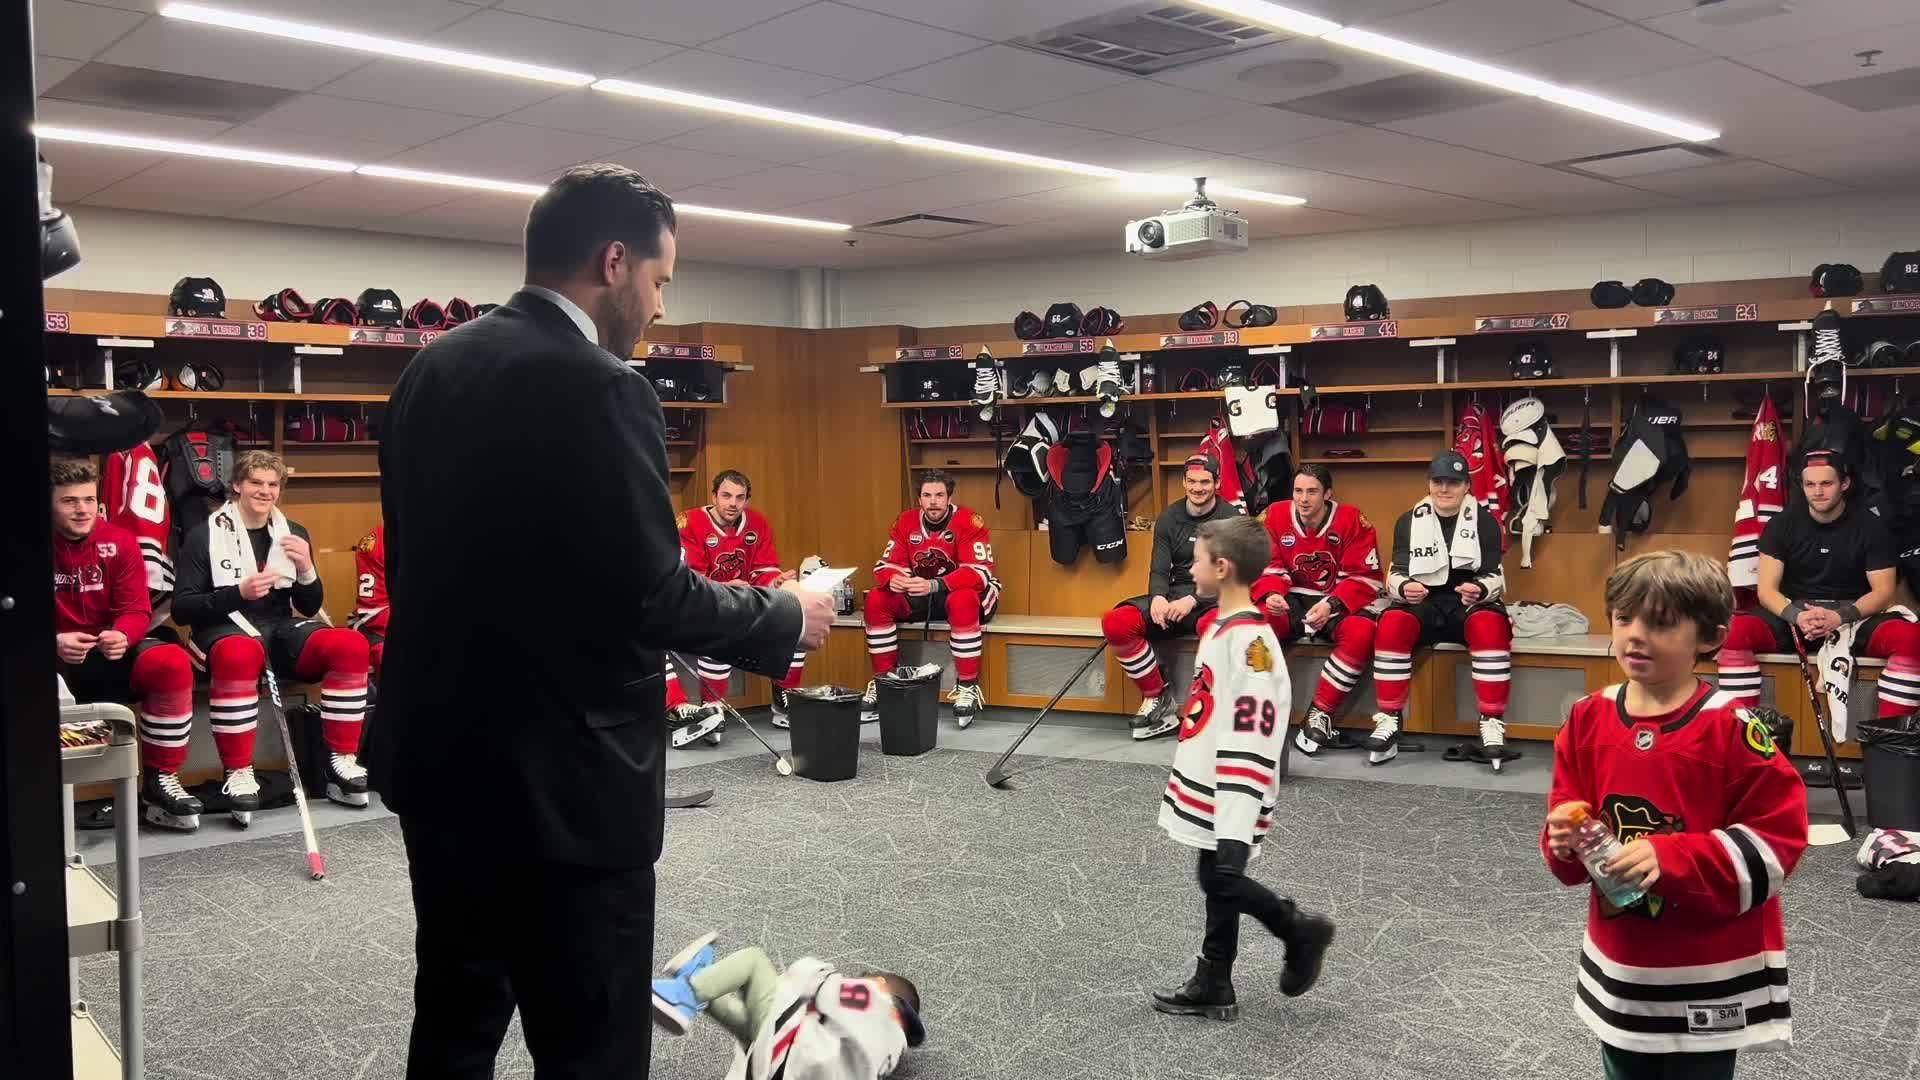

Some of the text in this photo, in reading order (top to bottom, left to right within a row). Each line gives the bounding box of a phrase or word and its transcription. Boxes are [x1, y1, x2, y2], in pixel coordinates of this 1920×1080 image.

[1905, 264, 1919, 273] 82
[1736, 304, 1757, 321] 24
[46, 313, 67, 330] 53
[1551, 313, 1569, 329] 47
[248, 323, 266, 339] 38
[1379, 322, 1397, 336] 44
[1224, 331, 1238, 344] 13
[701, 346, 714, 359] 63
[949, 345, 962, 358] 92
[1080, 339, 1094, 352] 56
[1521, 354, 1532, 364] 47
[1707, 351, 1718, 360] 24
[97, 543, 117, 558] 53
[1096, 538, 1124, 550] CCM
[973, 541, 994, 563] 92
[1365, 547, 1379, 570] 4
[359, 572, 375, 598] 2
[1232, 695, 1276, 737] 29
[1718, 1008, 1739, 1019] S/M
